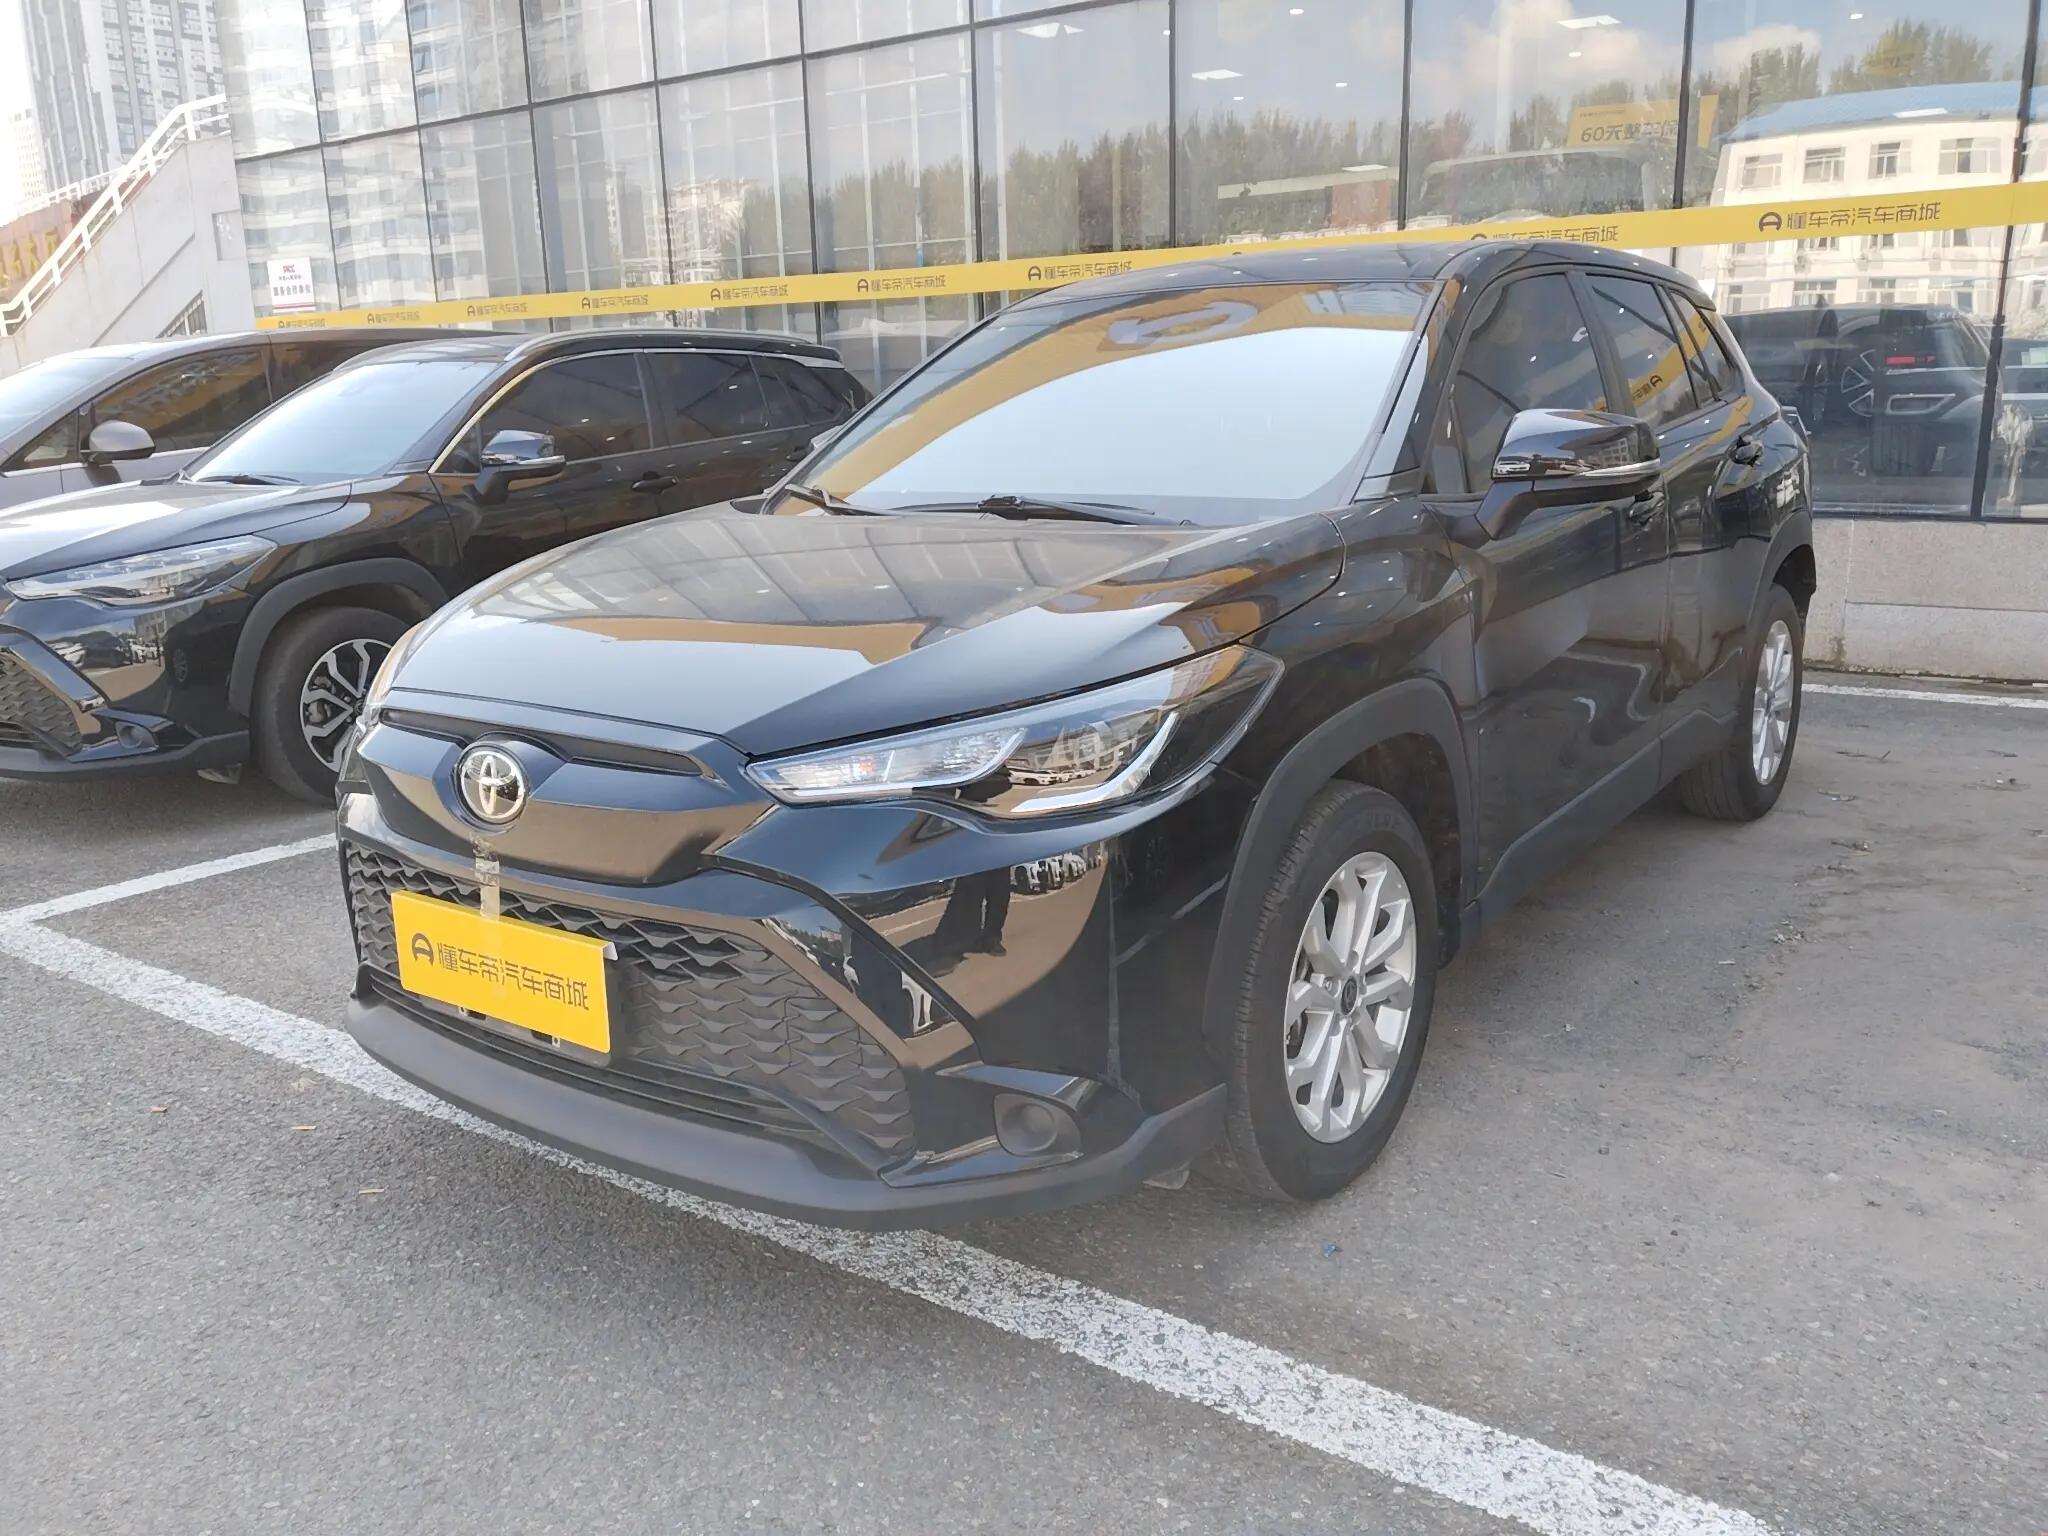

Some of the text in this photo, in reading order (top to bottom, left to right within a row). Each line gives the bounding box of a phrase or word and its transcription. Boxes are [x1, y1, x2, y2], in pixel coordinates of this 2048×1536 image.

[1786, 201, 1941, 231] 懂车帝汽车商城
[1044, 259, 1133, 279] 懂车帝汽车商城
[722, 284, 789, 300] 懂车帝汽车商城
[870, 274, 947, 292] 懂车帝汽车商城
[436, 941, 590, 1011] 懂车帝汽车商城
